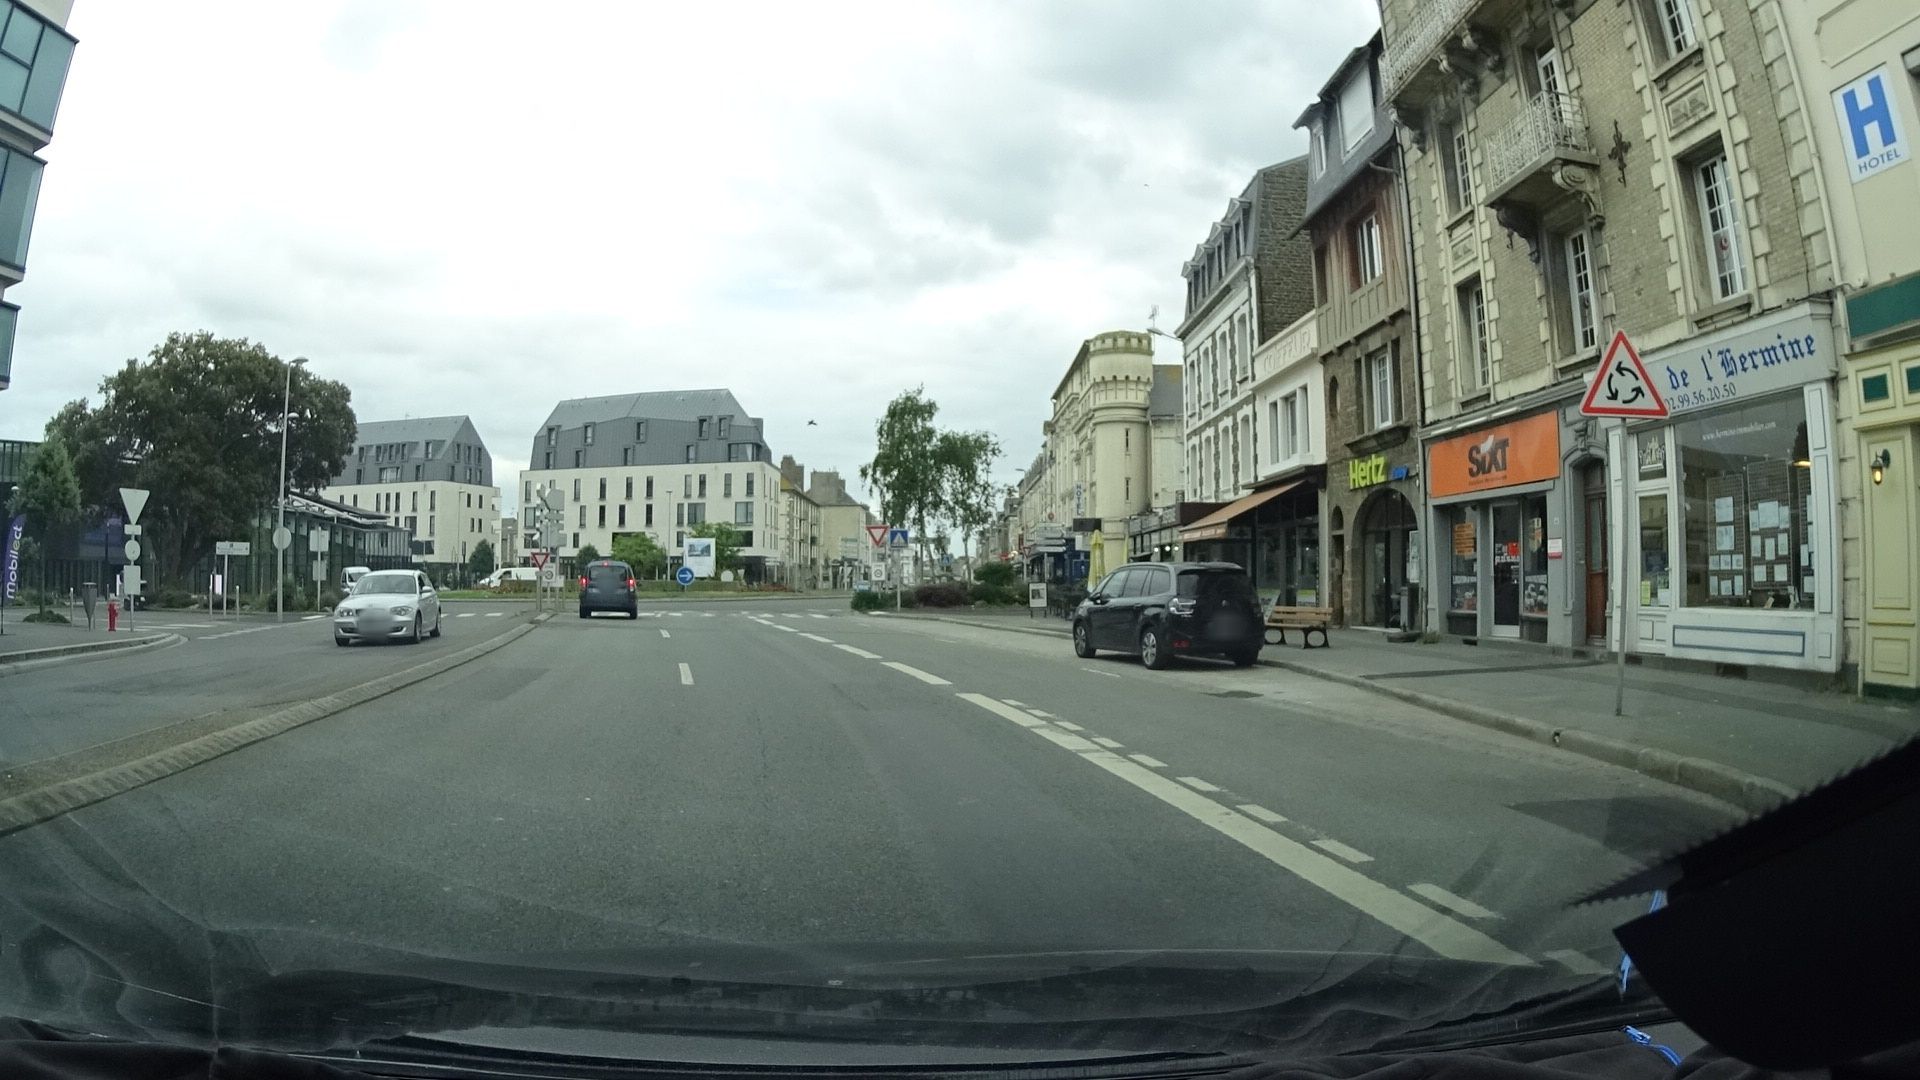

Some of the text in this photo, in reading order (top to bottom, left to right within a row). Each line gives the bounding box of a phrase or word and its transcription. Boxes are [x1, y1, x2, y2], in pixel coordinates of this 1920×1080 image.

[1842, 74, 1896, 160] H
[1857, 148, 1902, 174] HOTEL
[1666, 332, 1817, 391] de l'Hermine
[1349, 454, 1387, 490] Hertz
[6, 525, 23, 600] mobilect
